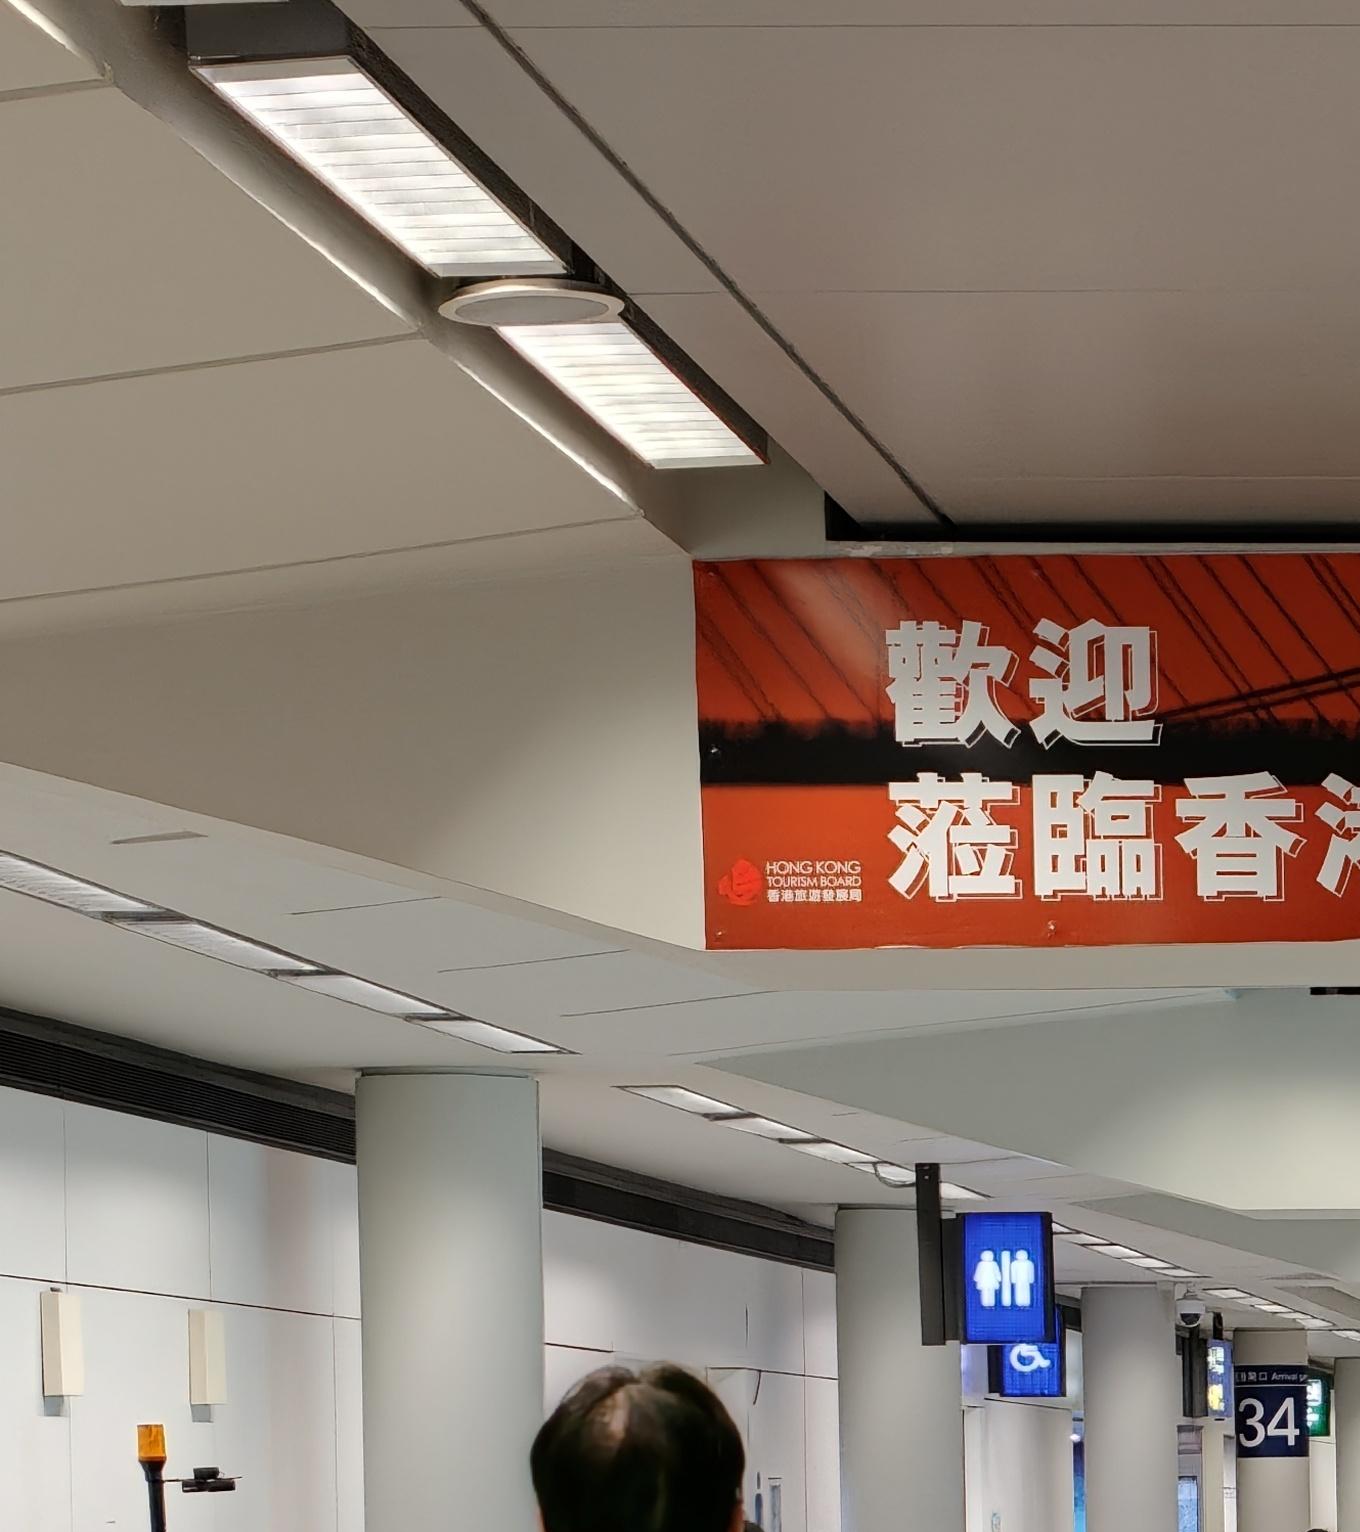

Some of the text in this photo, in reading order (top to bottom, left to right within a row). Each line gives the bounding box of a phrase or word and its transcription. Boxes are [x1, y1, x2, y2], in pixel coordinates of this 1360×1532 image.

[886, 618, 1162, 748] 歡迎
[766, 861, 861, 874] HONG KONG
[767, 876, 862, 887] TOURISM BOARD
[767, 889, 862, 902] 香港旅遊發展局
[1238, 1397, 1300, 1447] 34
